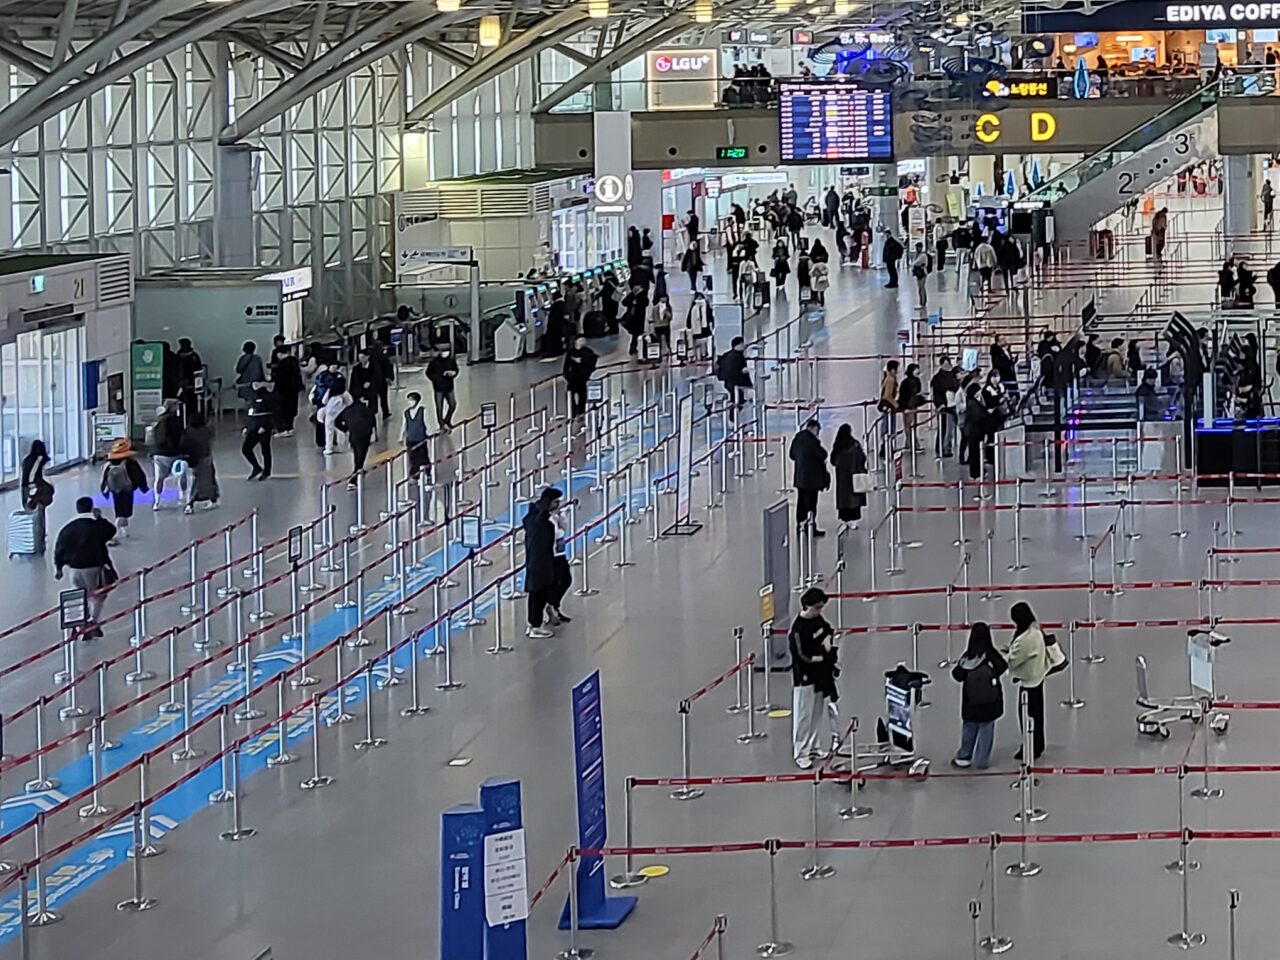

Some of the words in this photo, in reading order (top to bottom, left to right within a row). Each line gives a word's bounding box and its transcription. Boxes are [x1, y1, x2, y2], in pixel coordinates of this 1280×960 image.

[1166, 4, 1227, 22] EDIYA
[975, 113, 1001, 143] C
[1031, 112, 1057, 141] D
[73, 277, 84, 299] 21
